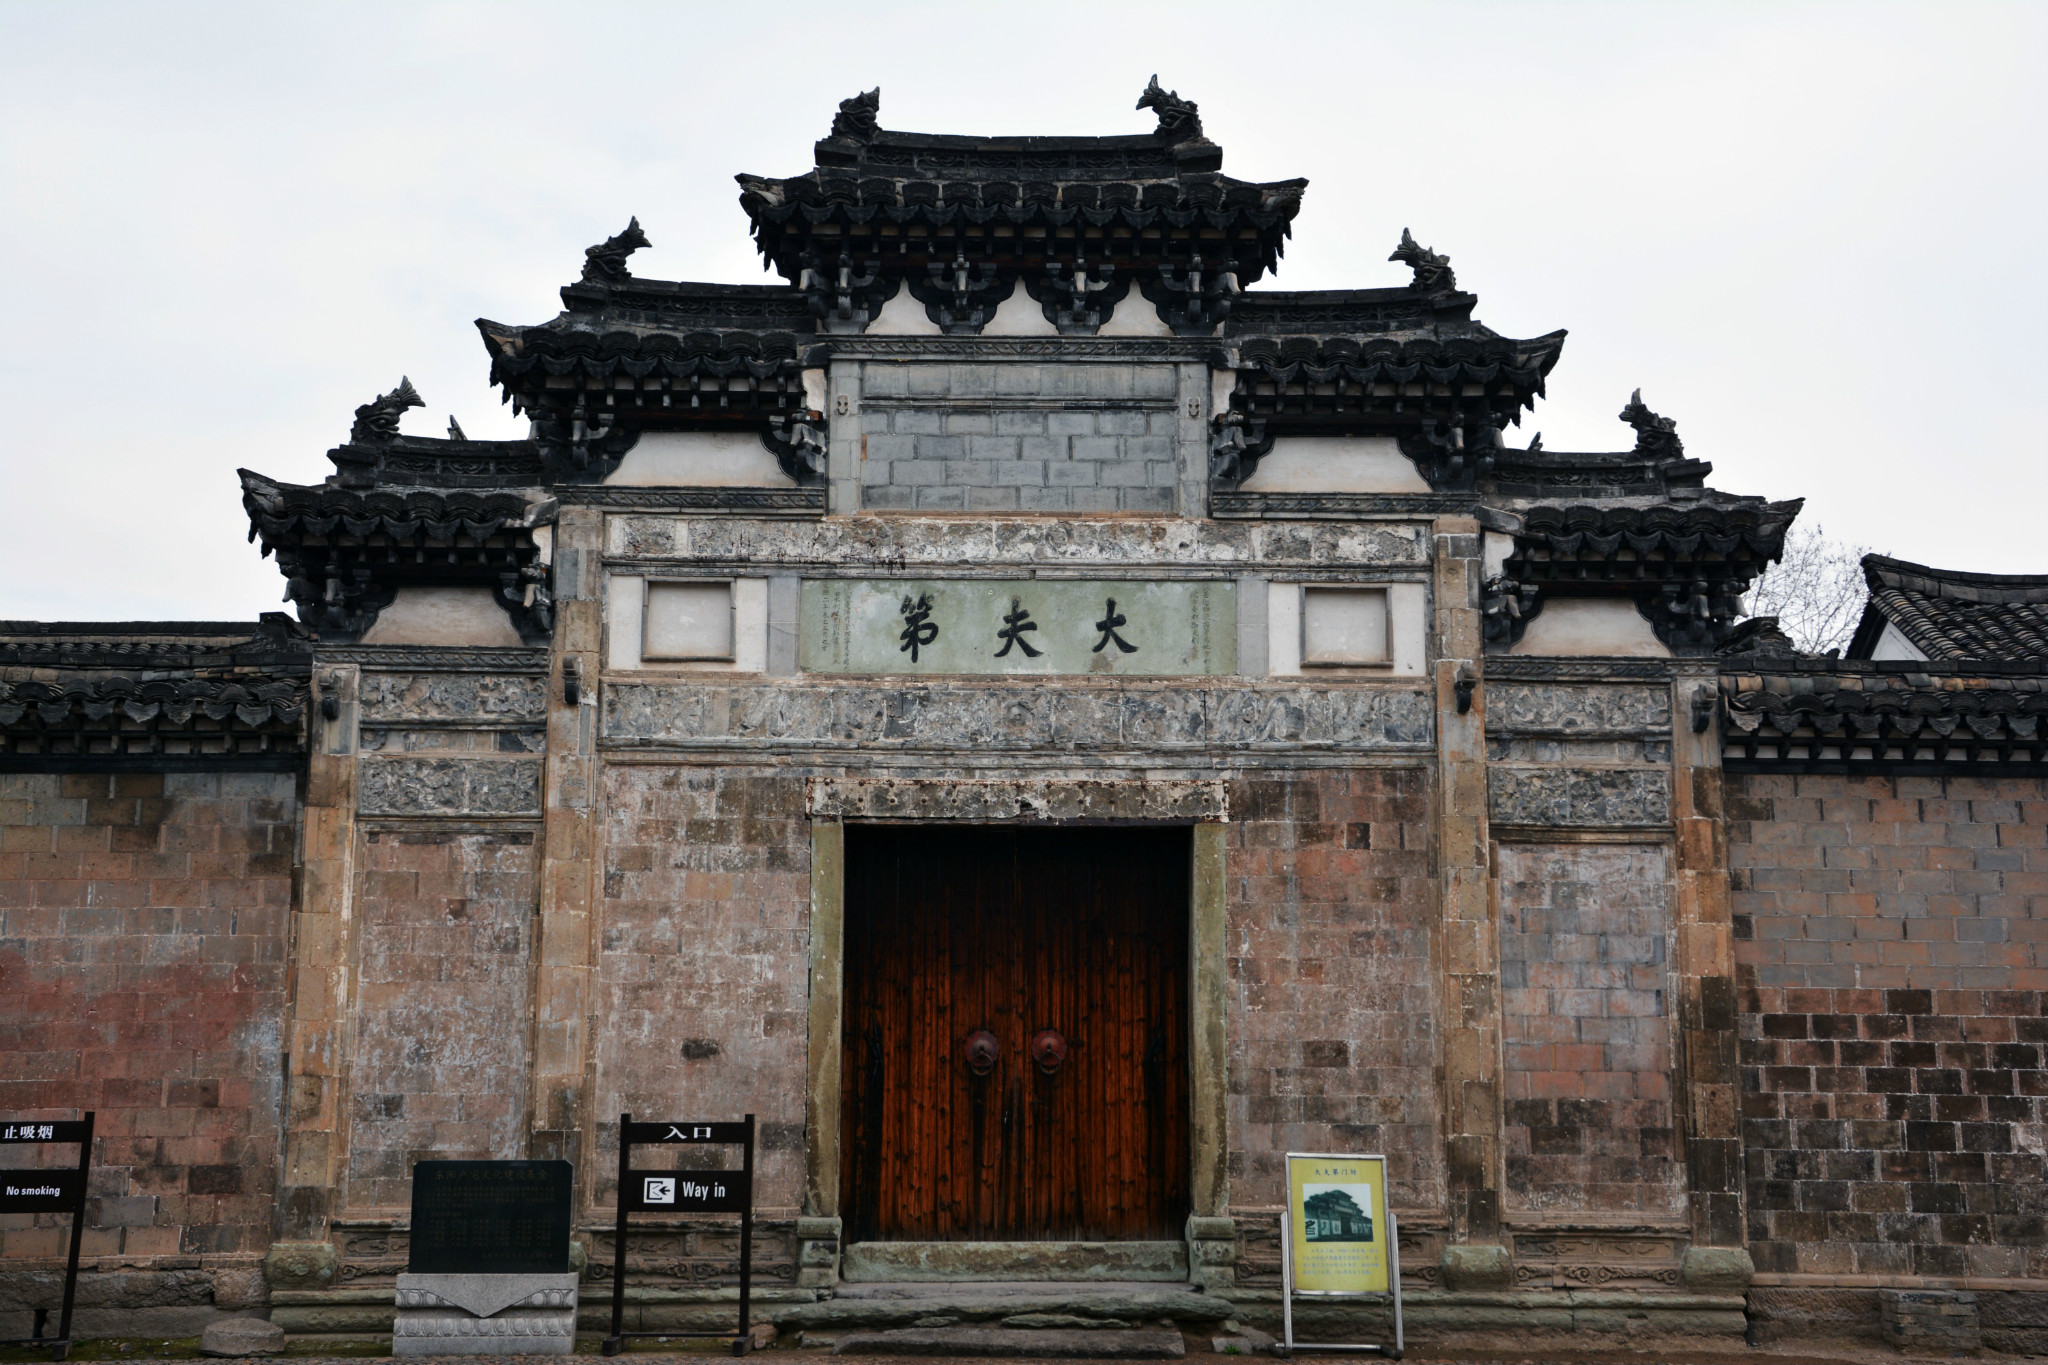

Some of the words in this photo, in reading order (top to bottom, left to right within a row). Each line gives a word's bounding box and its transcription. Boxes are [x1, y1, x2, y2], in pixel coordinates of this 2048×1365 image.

[3, 1125, 54, 1140] 止吸烟
[663, 1125, 712, 1140] 入口
[6, 1185, 20, 1196] No
[21, 1185, 61, 1197] smoking
[682, 1181, 709, 1201] Way
[714, 1181, 726, 1198] in
